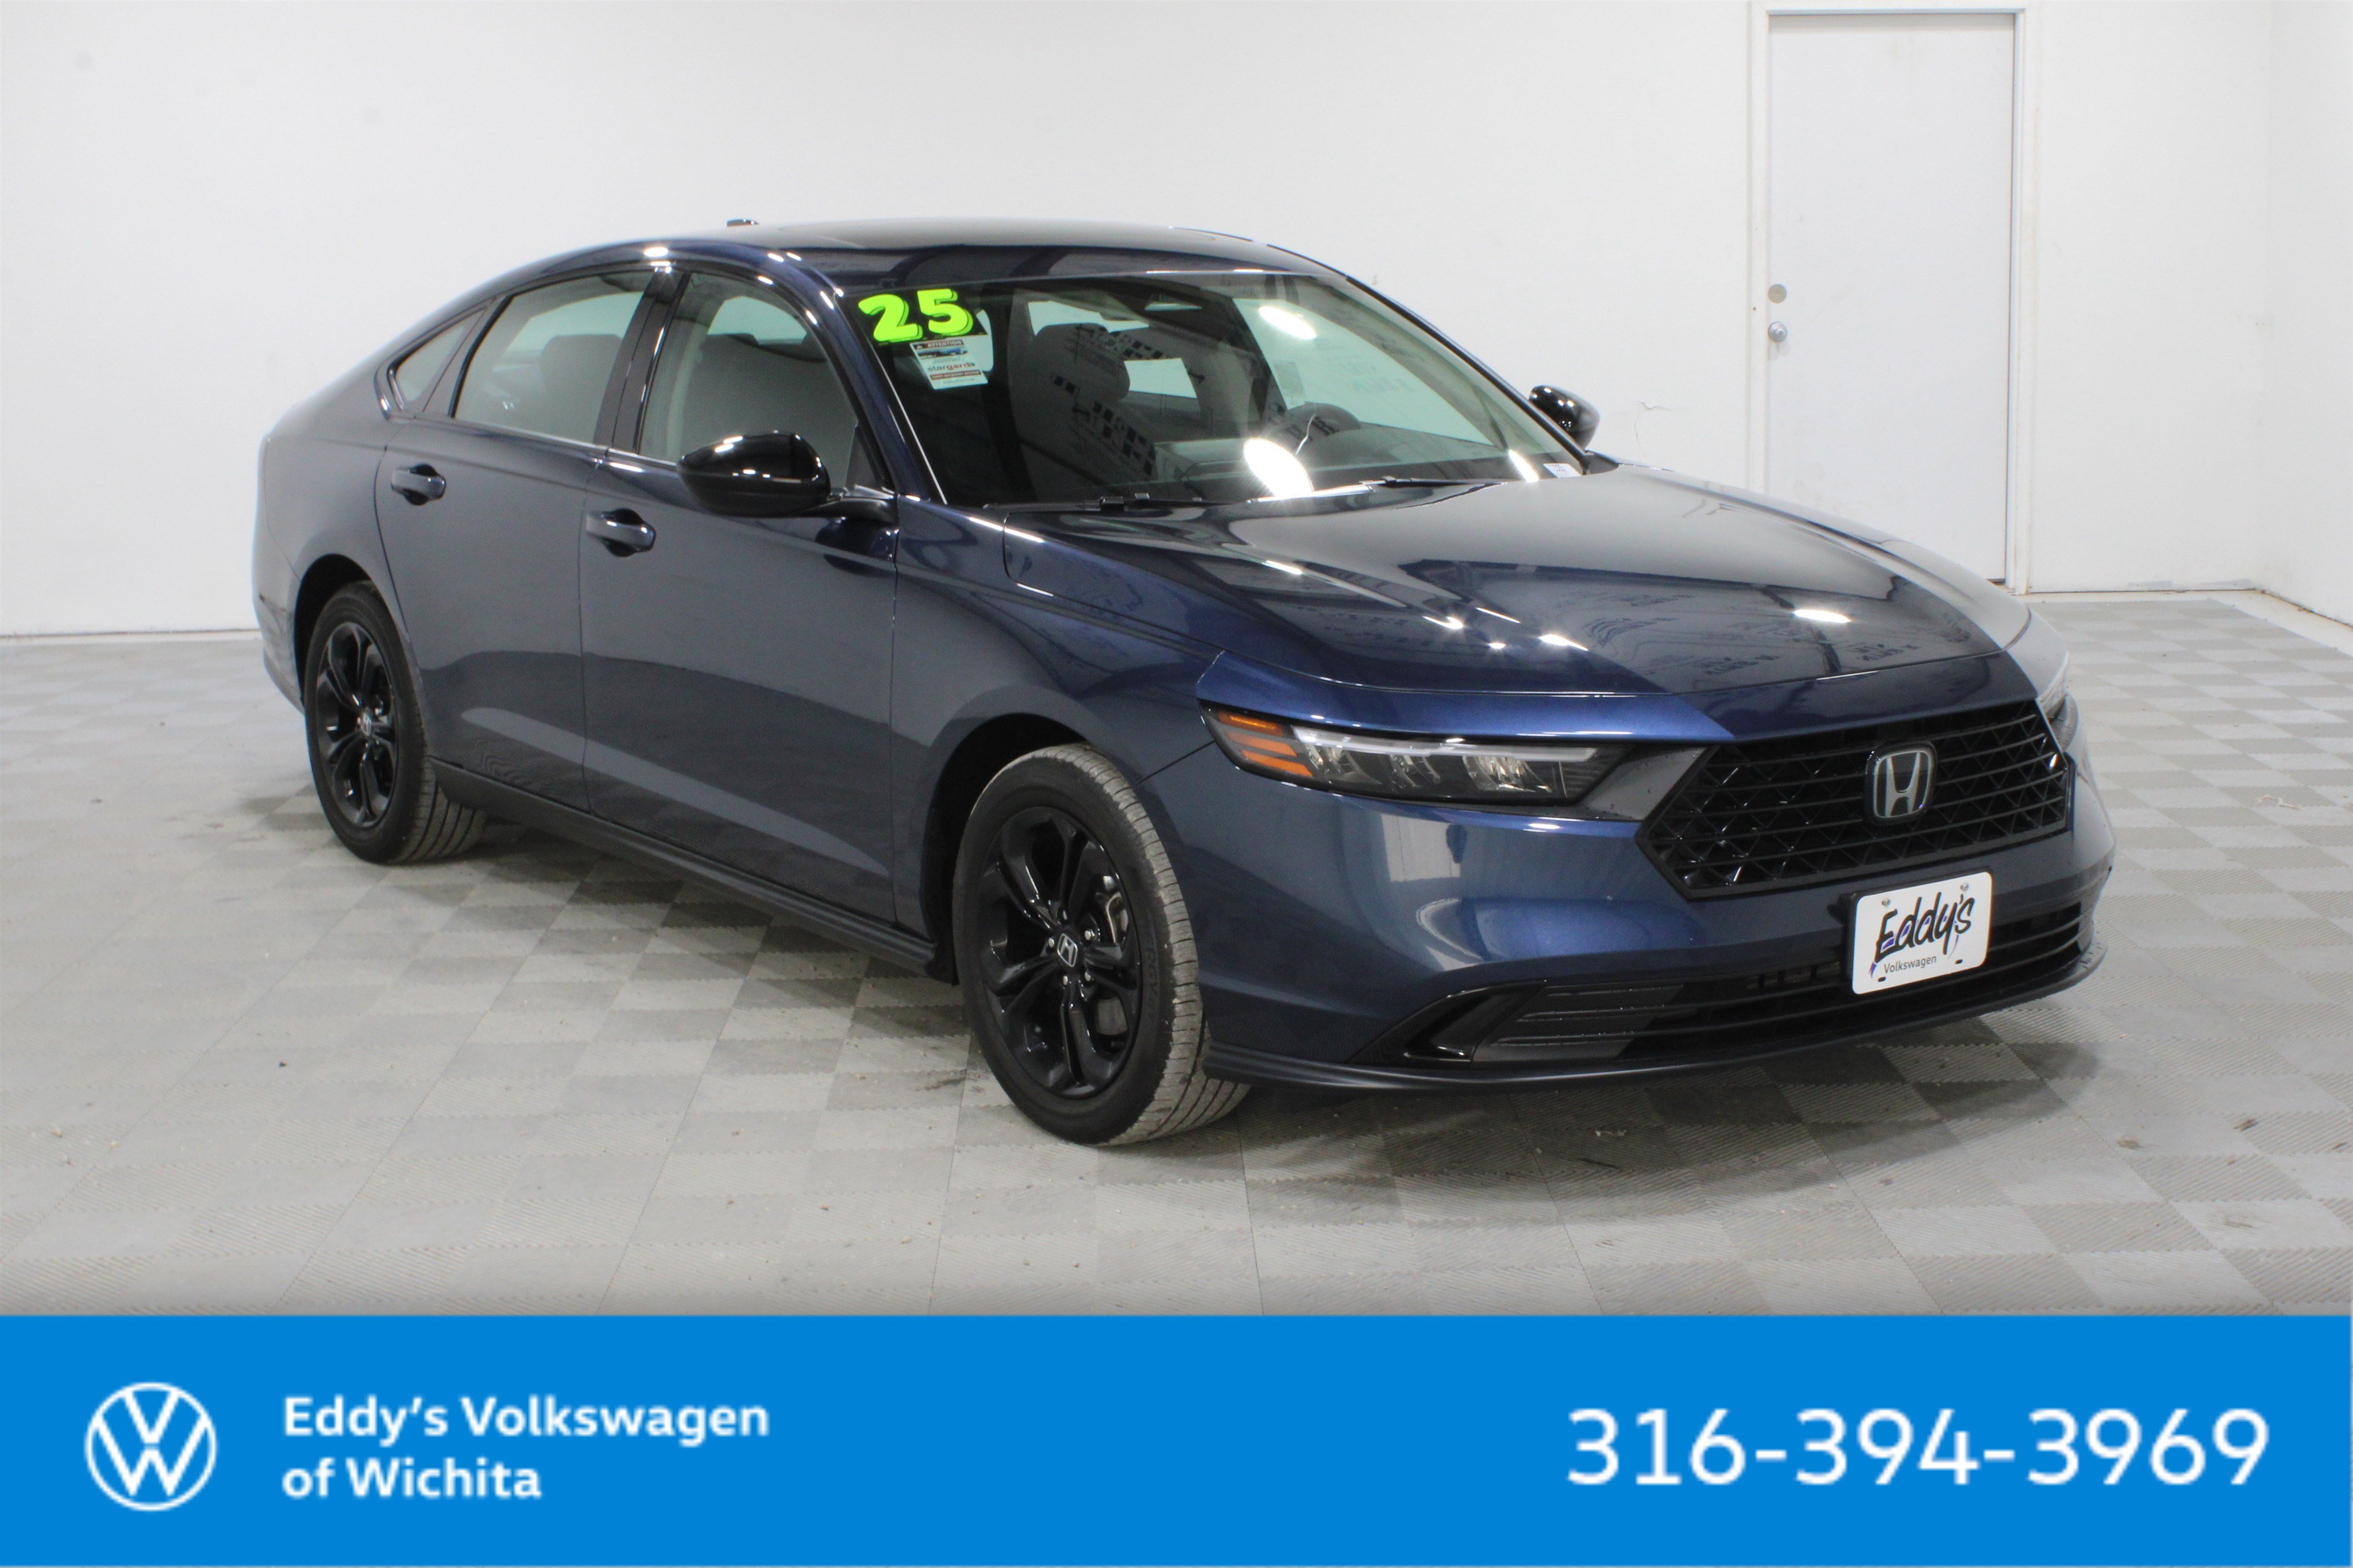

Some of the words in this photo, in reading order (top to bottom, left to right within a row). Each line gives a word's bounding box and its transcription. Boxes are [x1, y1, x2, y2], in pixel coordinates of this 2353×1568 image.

[858, 288, 974, 343] 25
[1874, 891, 1975, 964] Eddy's
[1883, 954, 1937, 974] Volkswagen
